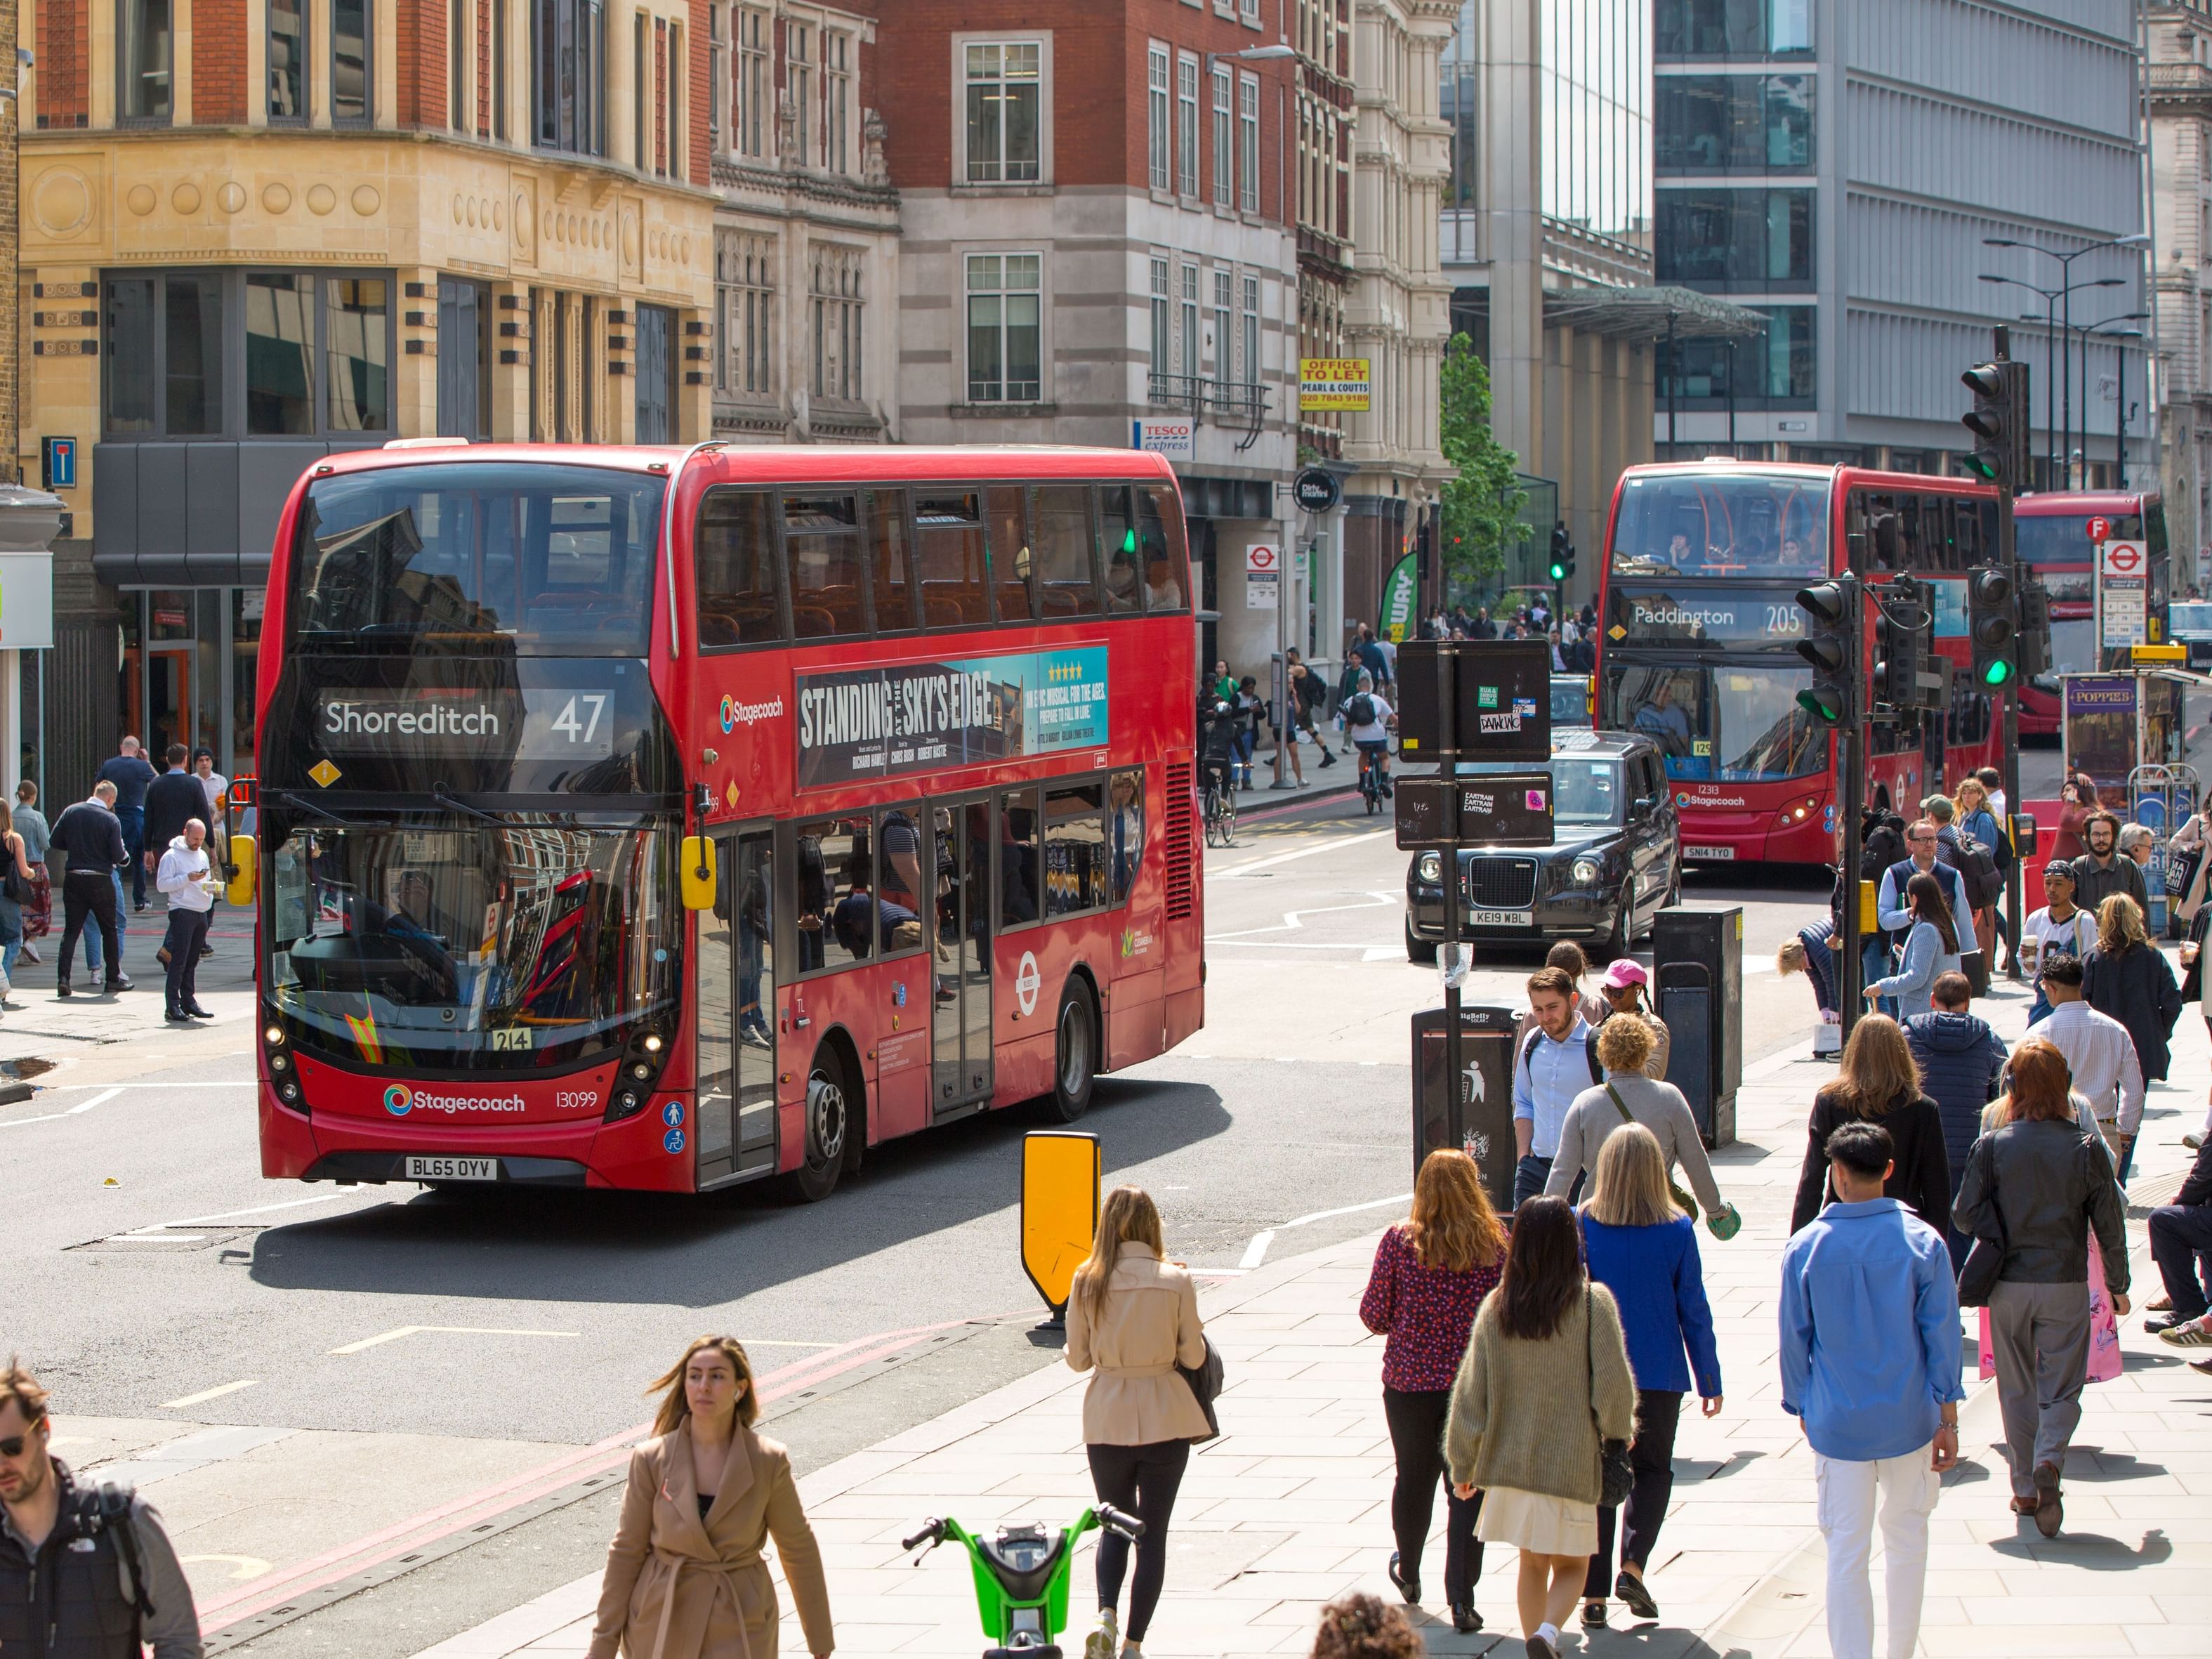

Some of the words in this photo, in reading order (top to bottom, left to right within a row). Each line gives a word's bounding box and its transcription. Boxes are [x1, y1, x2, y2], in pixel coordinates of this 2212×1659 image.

[1309, 361, 1361, 369] OFFICE
[1303, 370, 1326, 380] TO
[1334, 370, 1366, 380] LET
[1302, 383, 1326, 392] PEARL
[1329, 383, 1335, 392] &
[1338, 383, 1368, 392] COUTTS
[1145, 426, 1188, 435] TESCO
[1145, 441, 1189, 452] express
[1302, 483, 1320, 493] Dirty
[2093, 520, 2104, 537] F
[1635, 606, 1733, 629] Paddington
[1767, 605, 1799, 632] 205
[1046, 686, 1069, 707] MUSICAL
[1070, 685, 1080, 702] FOR
[1081, 683, 1091, 701] THE
[2076, 691, 2129, 702] POPPIE'S
[734, 695, 783, 726] Stagecoach
[801, 680, 893, 749] STANDING
[895, 716, 902, 737] AT
[903, 674, 948, 736] SKY'S
[950, 670, 992, 729] EDGE
[1039, 707, 1058, 725] PREPARE
[1058, 707, 1064, 722] TO
[1065, 707, 1074, 721] FALL
[1074, 706, 1079, 720] IN
[325, 702, 499, 735] Shoreditch
[551, 695, 607, 743] 47
[891, 750, 903, 764] CHRIS
[903, 749, 914, 763] BUSH
[918, 746, 933, 760] ROBERT
[933, 744, 947, 759] HASTIE
[852, 754, 870, 770] RICHARD
[1699, 785, 1719, 794] 12313
[1691, 795, 1744, 806] Stagecoach
[1690, 848, 1709, 857] SN14
[1712, 849, 1729, 858] TYO
[1477, 912, 1501, 923] KE19
[1504, 913, 1525, 923] WBL
[797, 999, 805, 1013] TL
[496, 1031, 528, 1051] 214
[414, 1091, 525, 1114] Stagecoach
[556, 1091, 597, 1108] 13099
[413, 1159, 454, 1176] BL65
[458, 1160, 489, 1177] OYV
